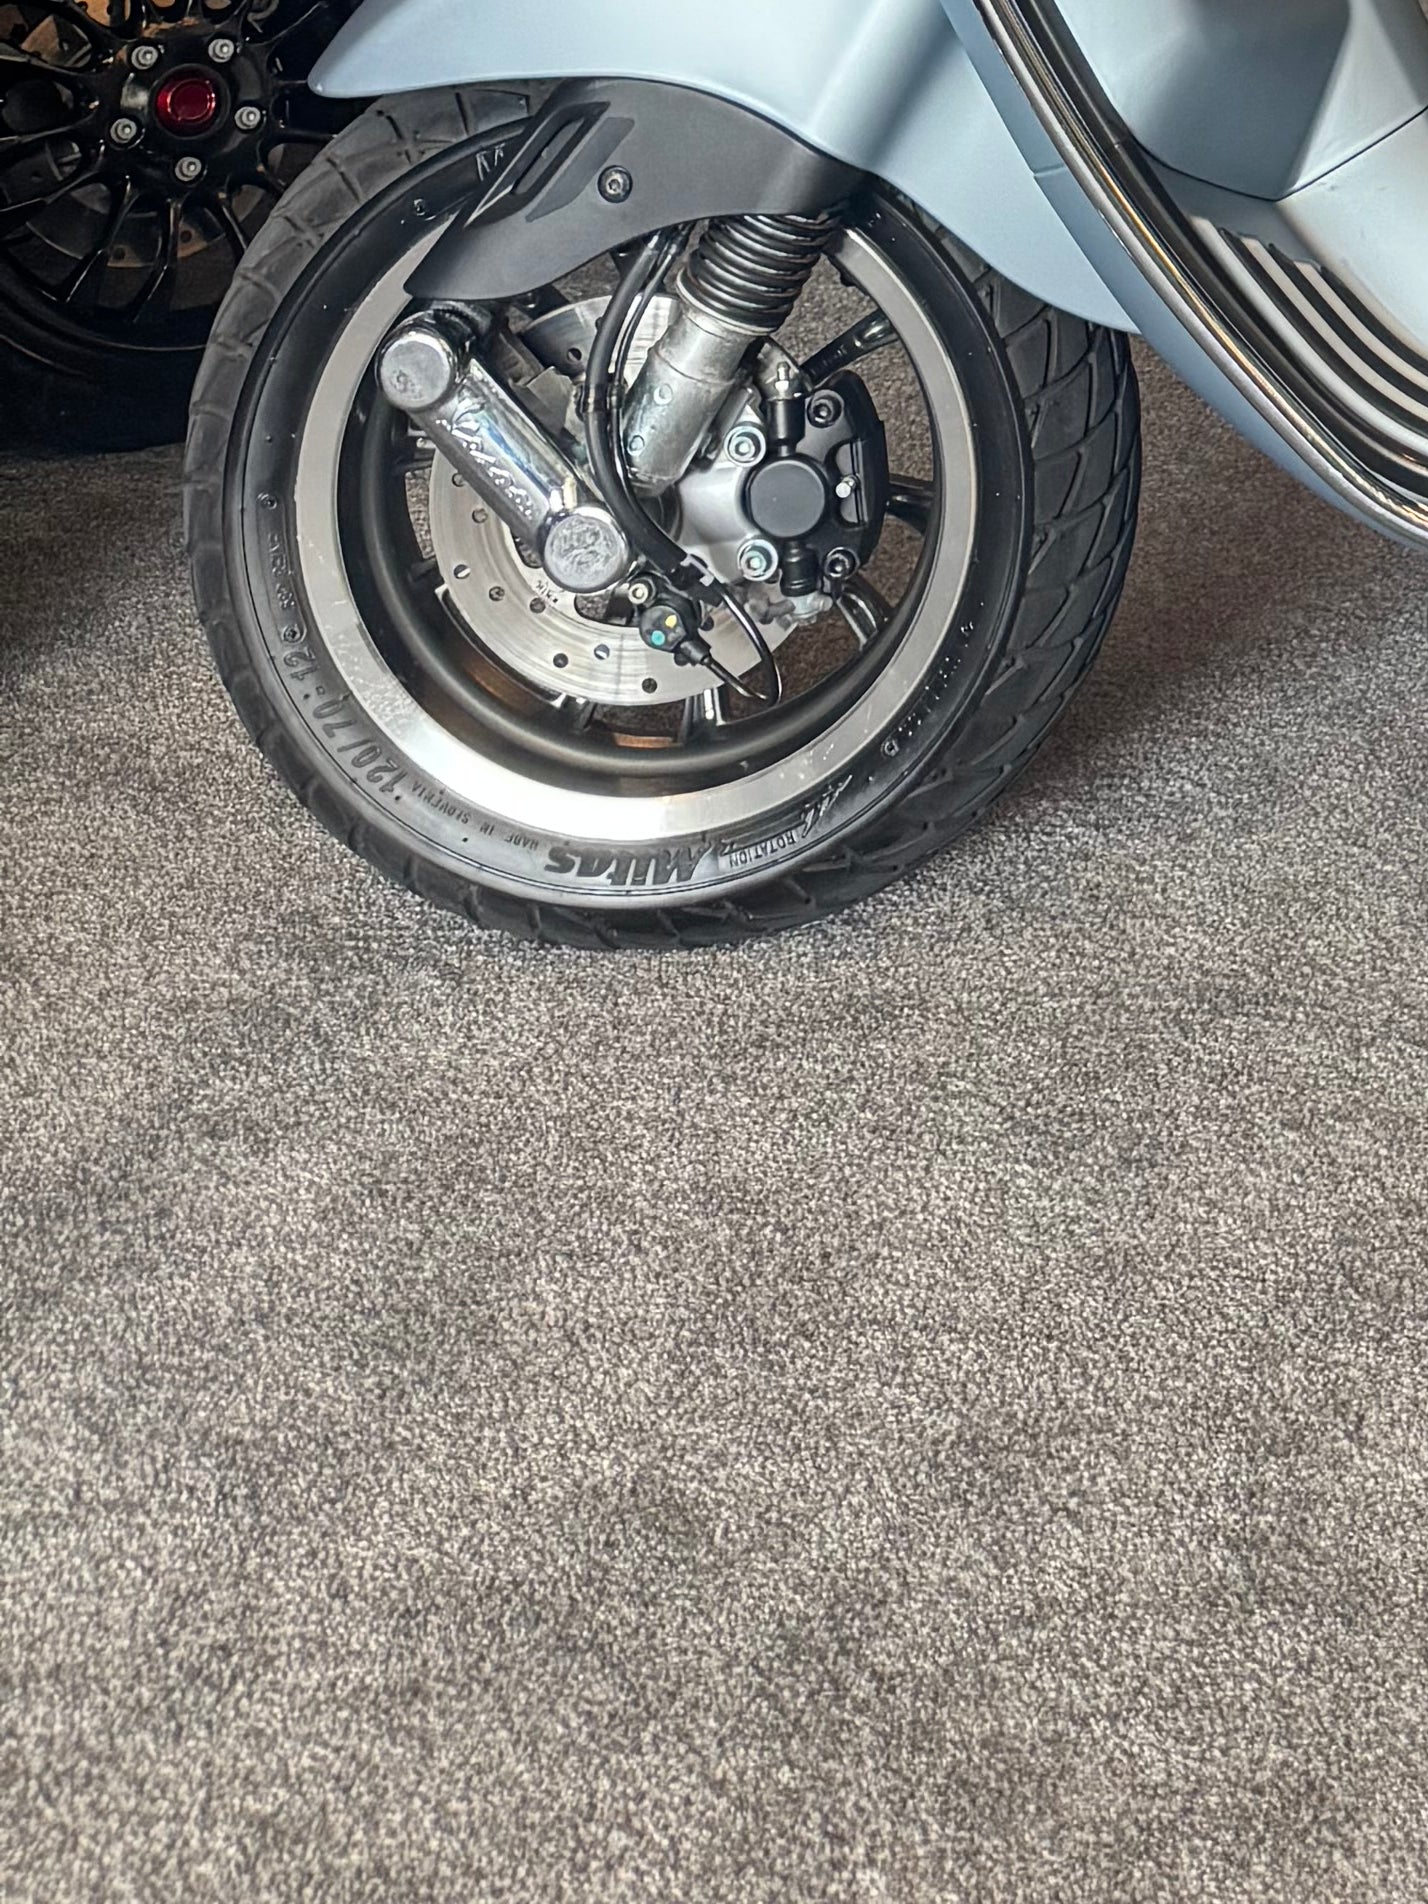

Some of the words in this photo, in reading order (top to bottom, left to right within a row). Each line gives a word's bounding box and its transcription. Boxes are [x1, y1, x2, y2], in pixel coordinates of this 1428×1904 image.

[479, 820, 496, 836] IN
[543, 840, 712, 886] Mitas
[728, 829, 797, 869] ROTATION
